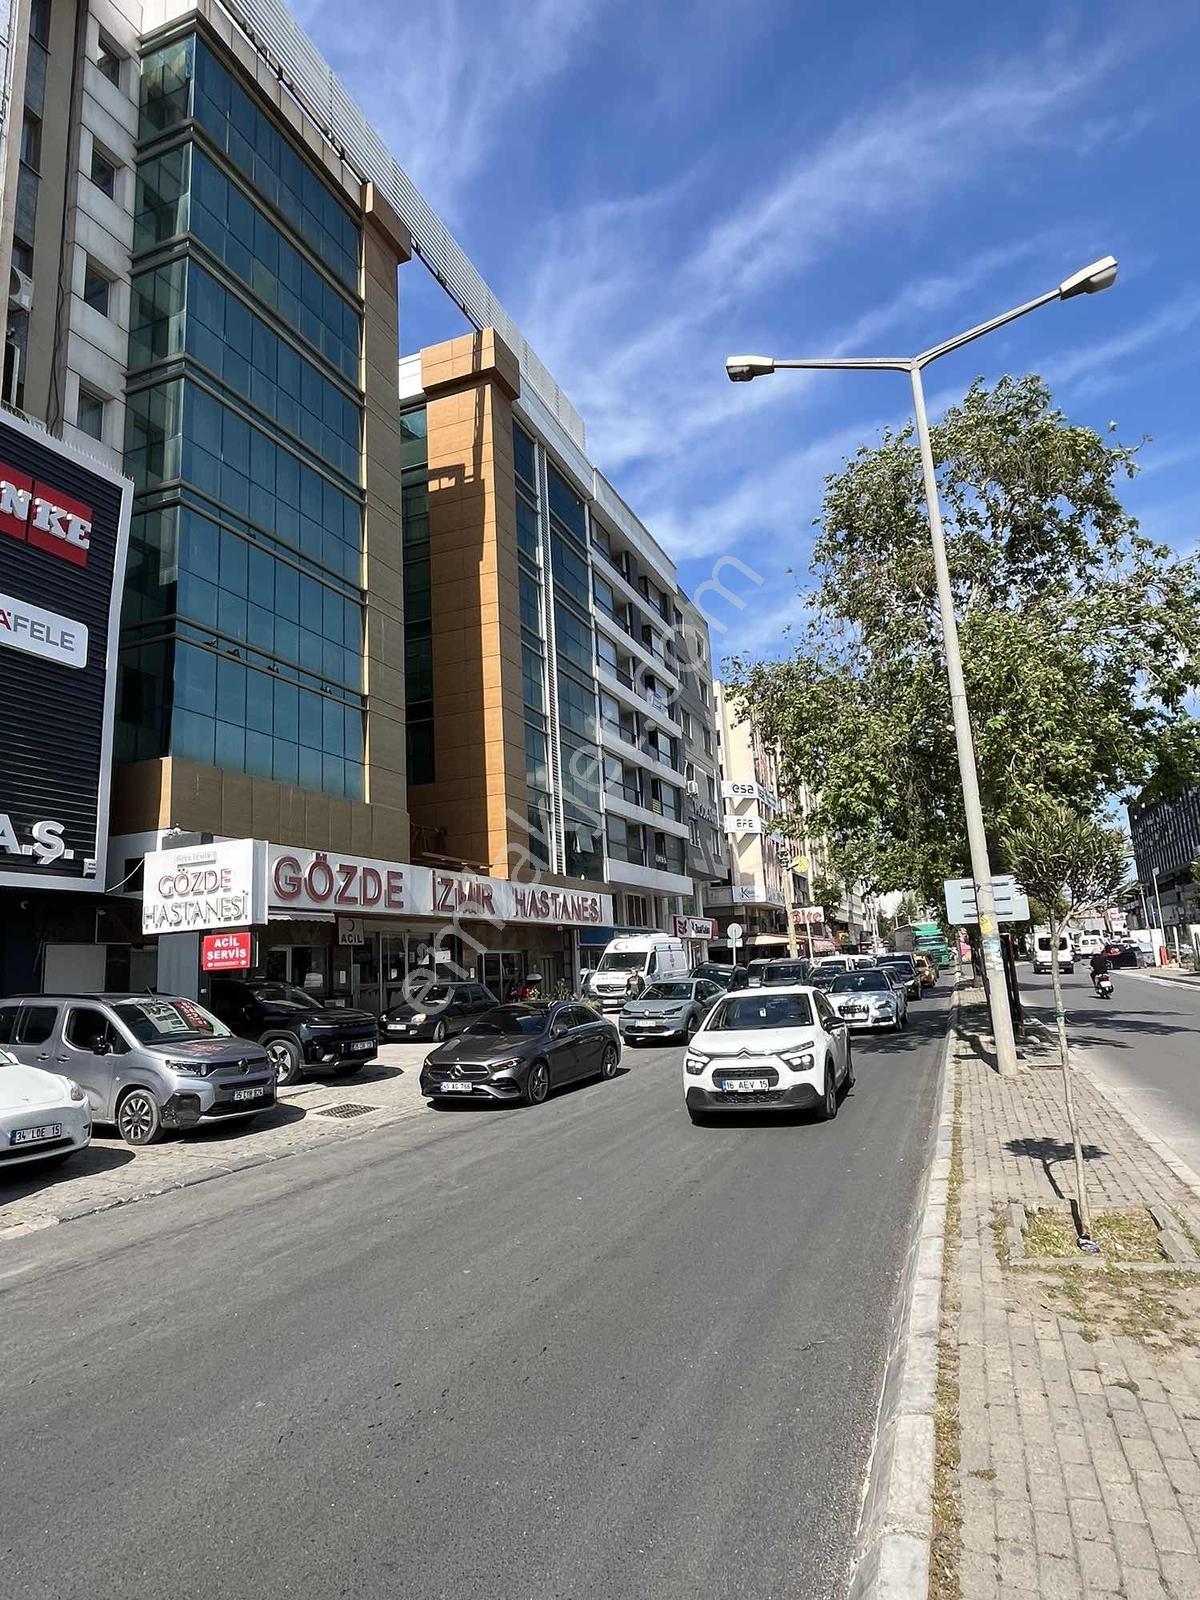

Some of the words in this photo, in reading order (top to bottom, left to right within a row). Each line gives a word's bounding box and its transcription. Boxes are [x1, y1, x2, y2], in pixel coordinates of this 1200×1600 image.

[732, 783, 754, 794] esa
[158, 867, 232, 898] GÖZDE
[272, 851, 404, 909] GÖZDE
[513, 887, 603, 923] HASTANESİ
[143, 889, 249, 928] HASTANESİ
[214, 936, 240, 948] ACİL
[207, 947, 247, 960] SERVİS
[726, 1081, 735, 1090] 16
[738, 1081, 755, 1090] AEV
[759, 1080, 768, 1089] 15
[16, 1131, 26, 1141] 34
[52, 1125, 60, 1136] 15
